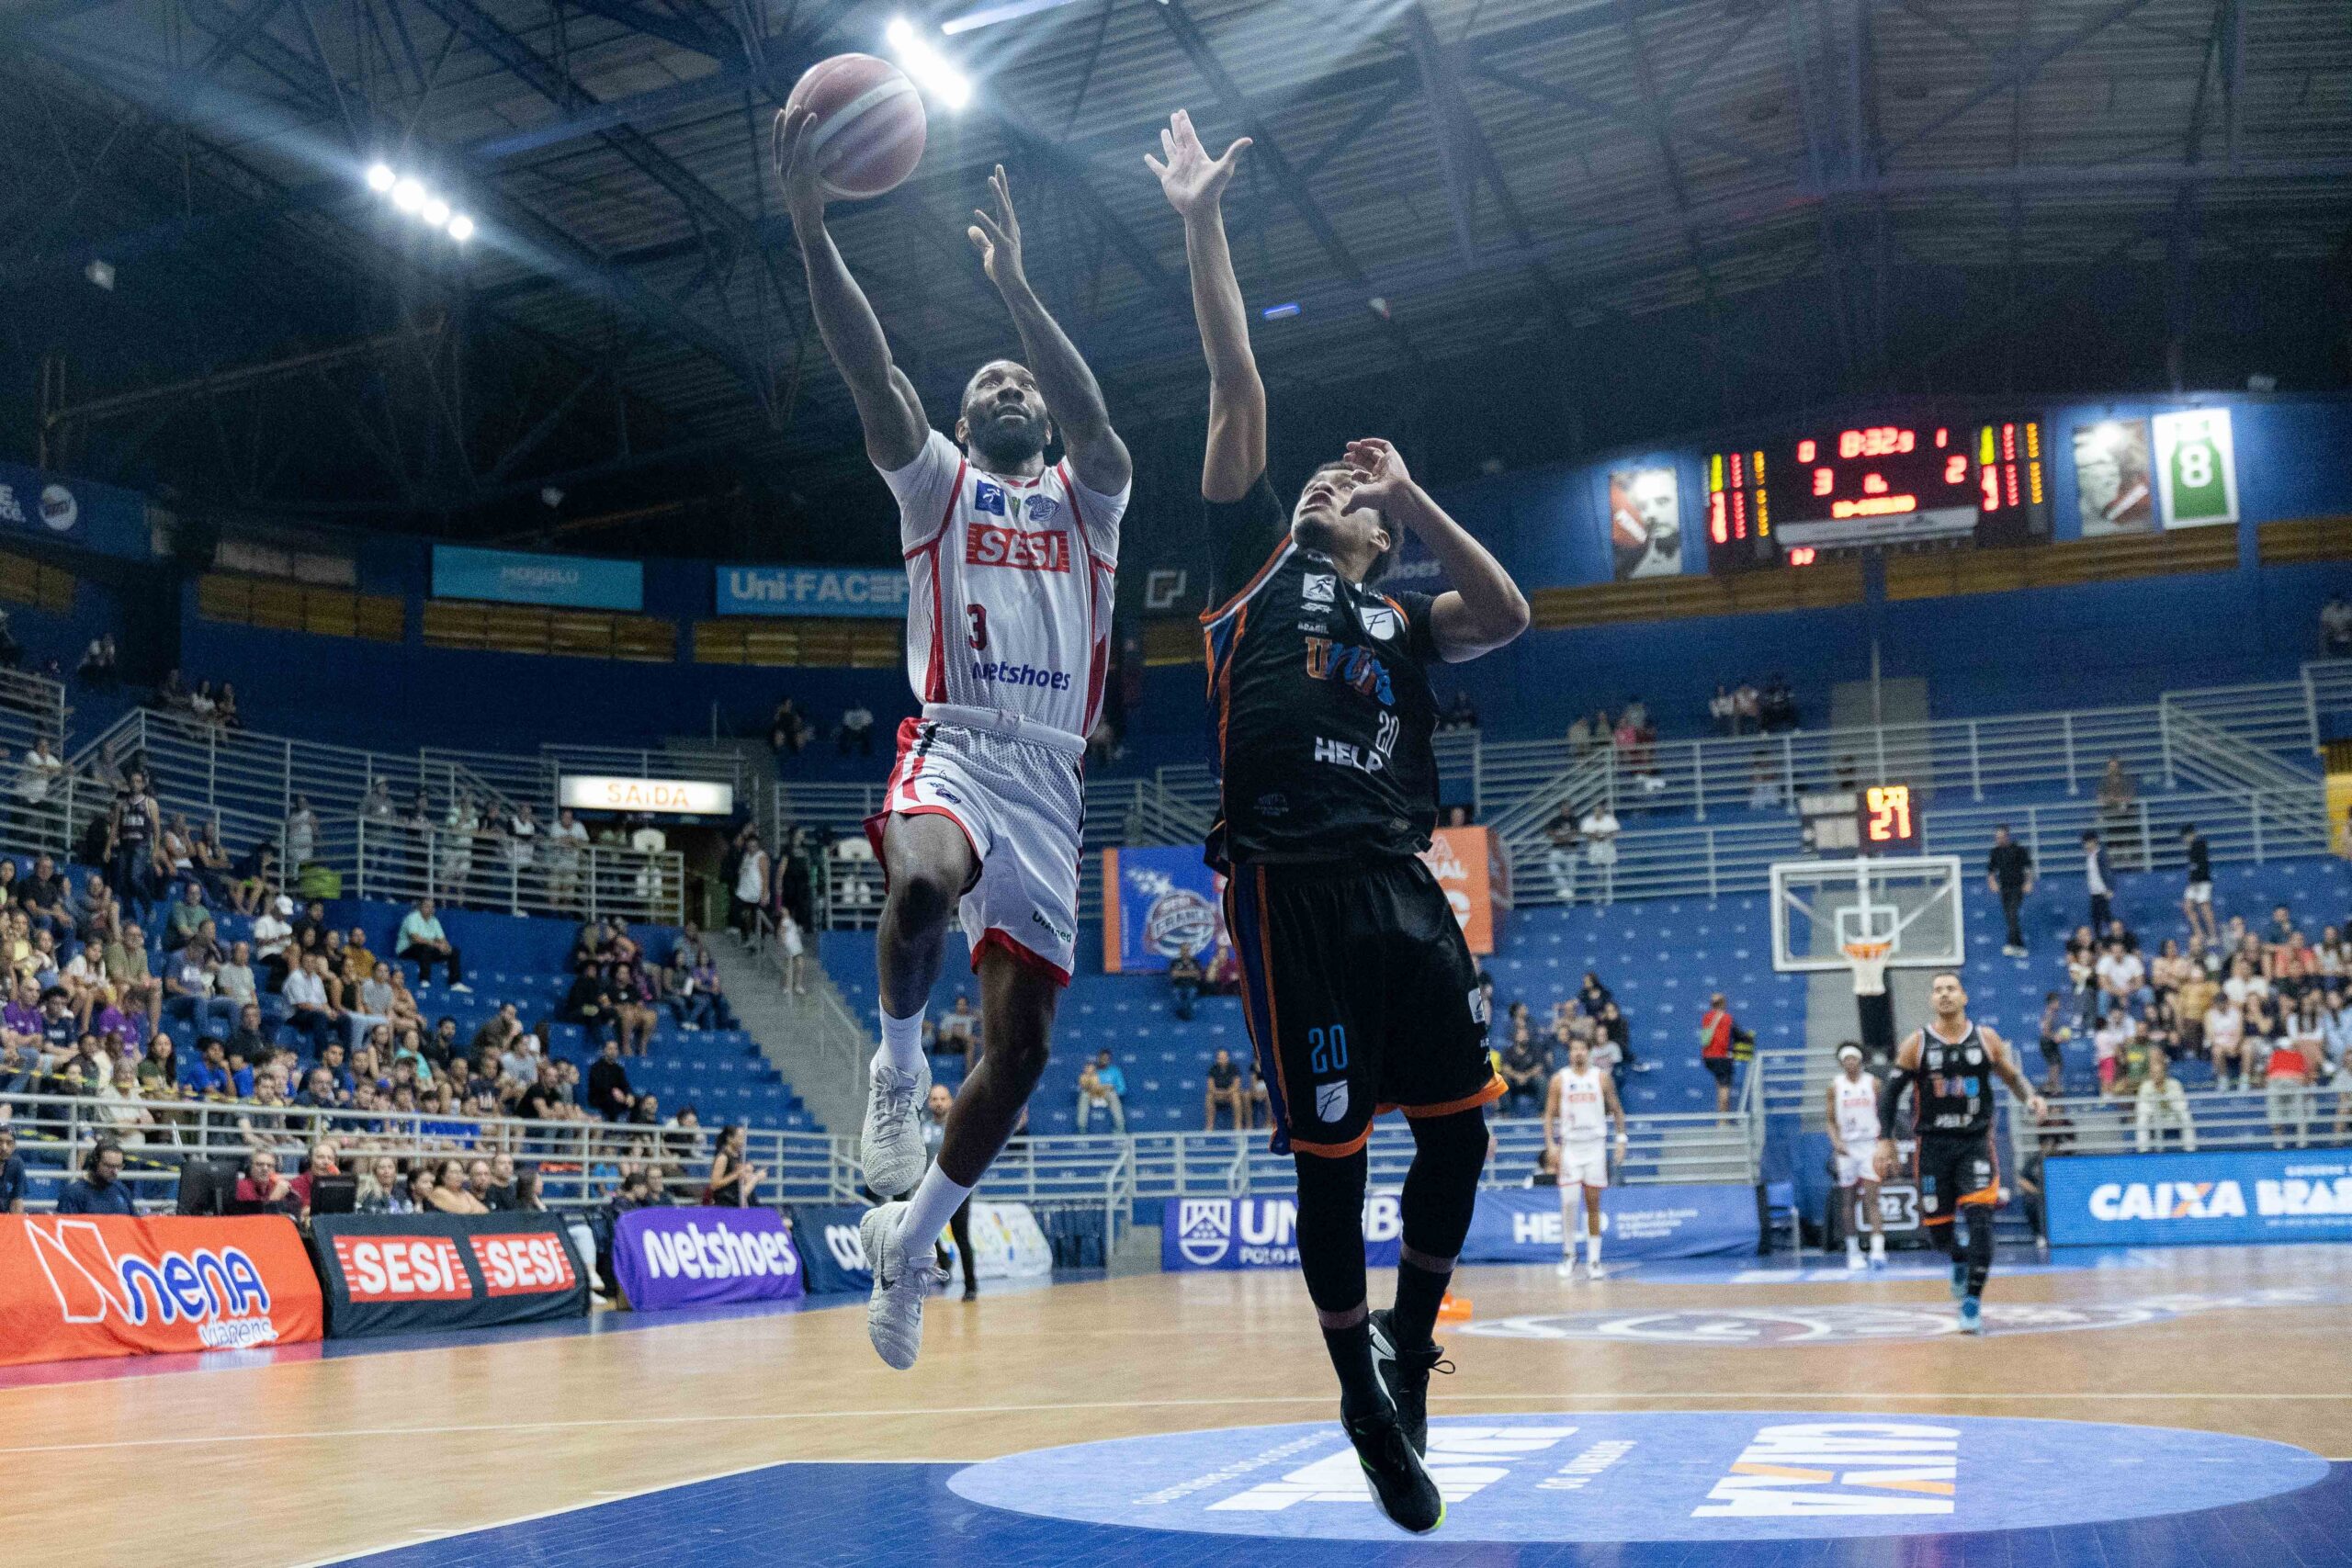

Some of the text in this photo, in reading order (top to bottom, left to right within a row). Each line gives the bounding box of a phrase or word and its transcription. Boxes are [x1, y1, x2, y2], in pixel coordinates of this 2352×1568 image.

[2179, 444, 2213, 488] 8
[977, 529, 1058, 569] SESI
[967, 604, 987, 650] 3
[1314, 736, 1382, 774] HELP
[1375, 710, 1399, 760] 20
[1308, 1023, 1348, 1073] 20
[2087, 1179, 2248, 1222] CAIXA
[353, 1241, 456, 1294] SESI
[485, 1238, 566, 1288] SESI
[1690, 1423, 1962, 1517] CAIXA
